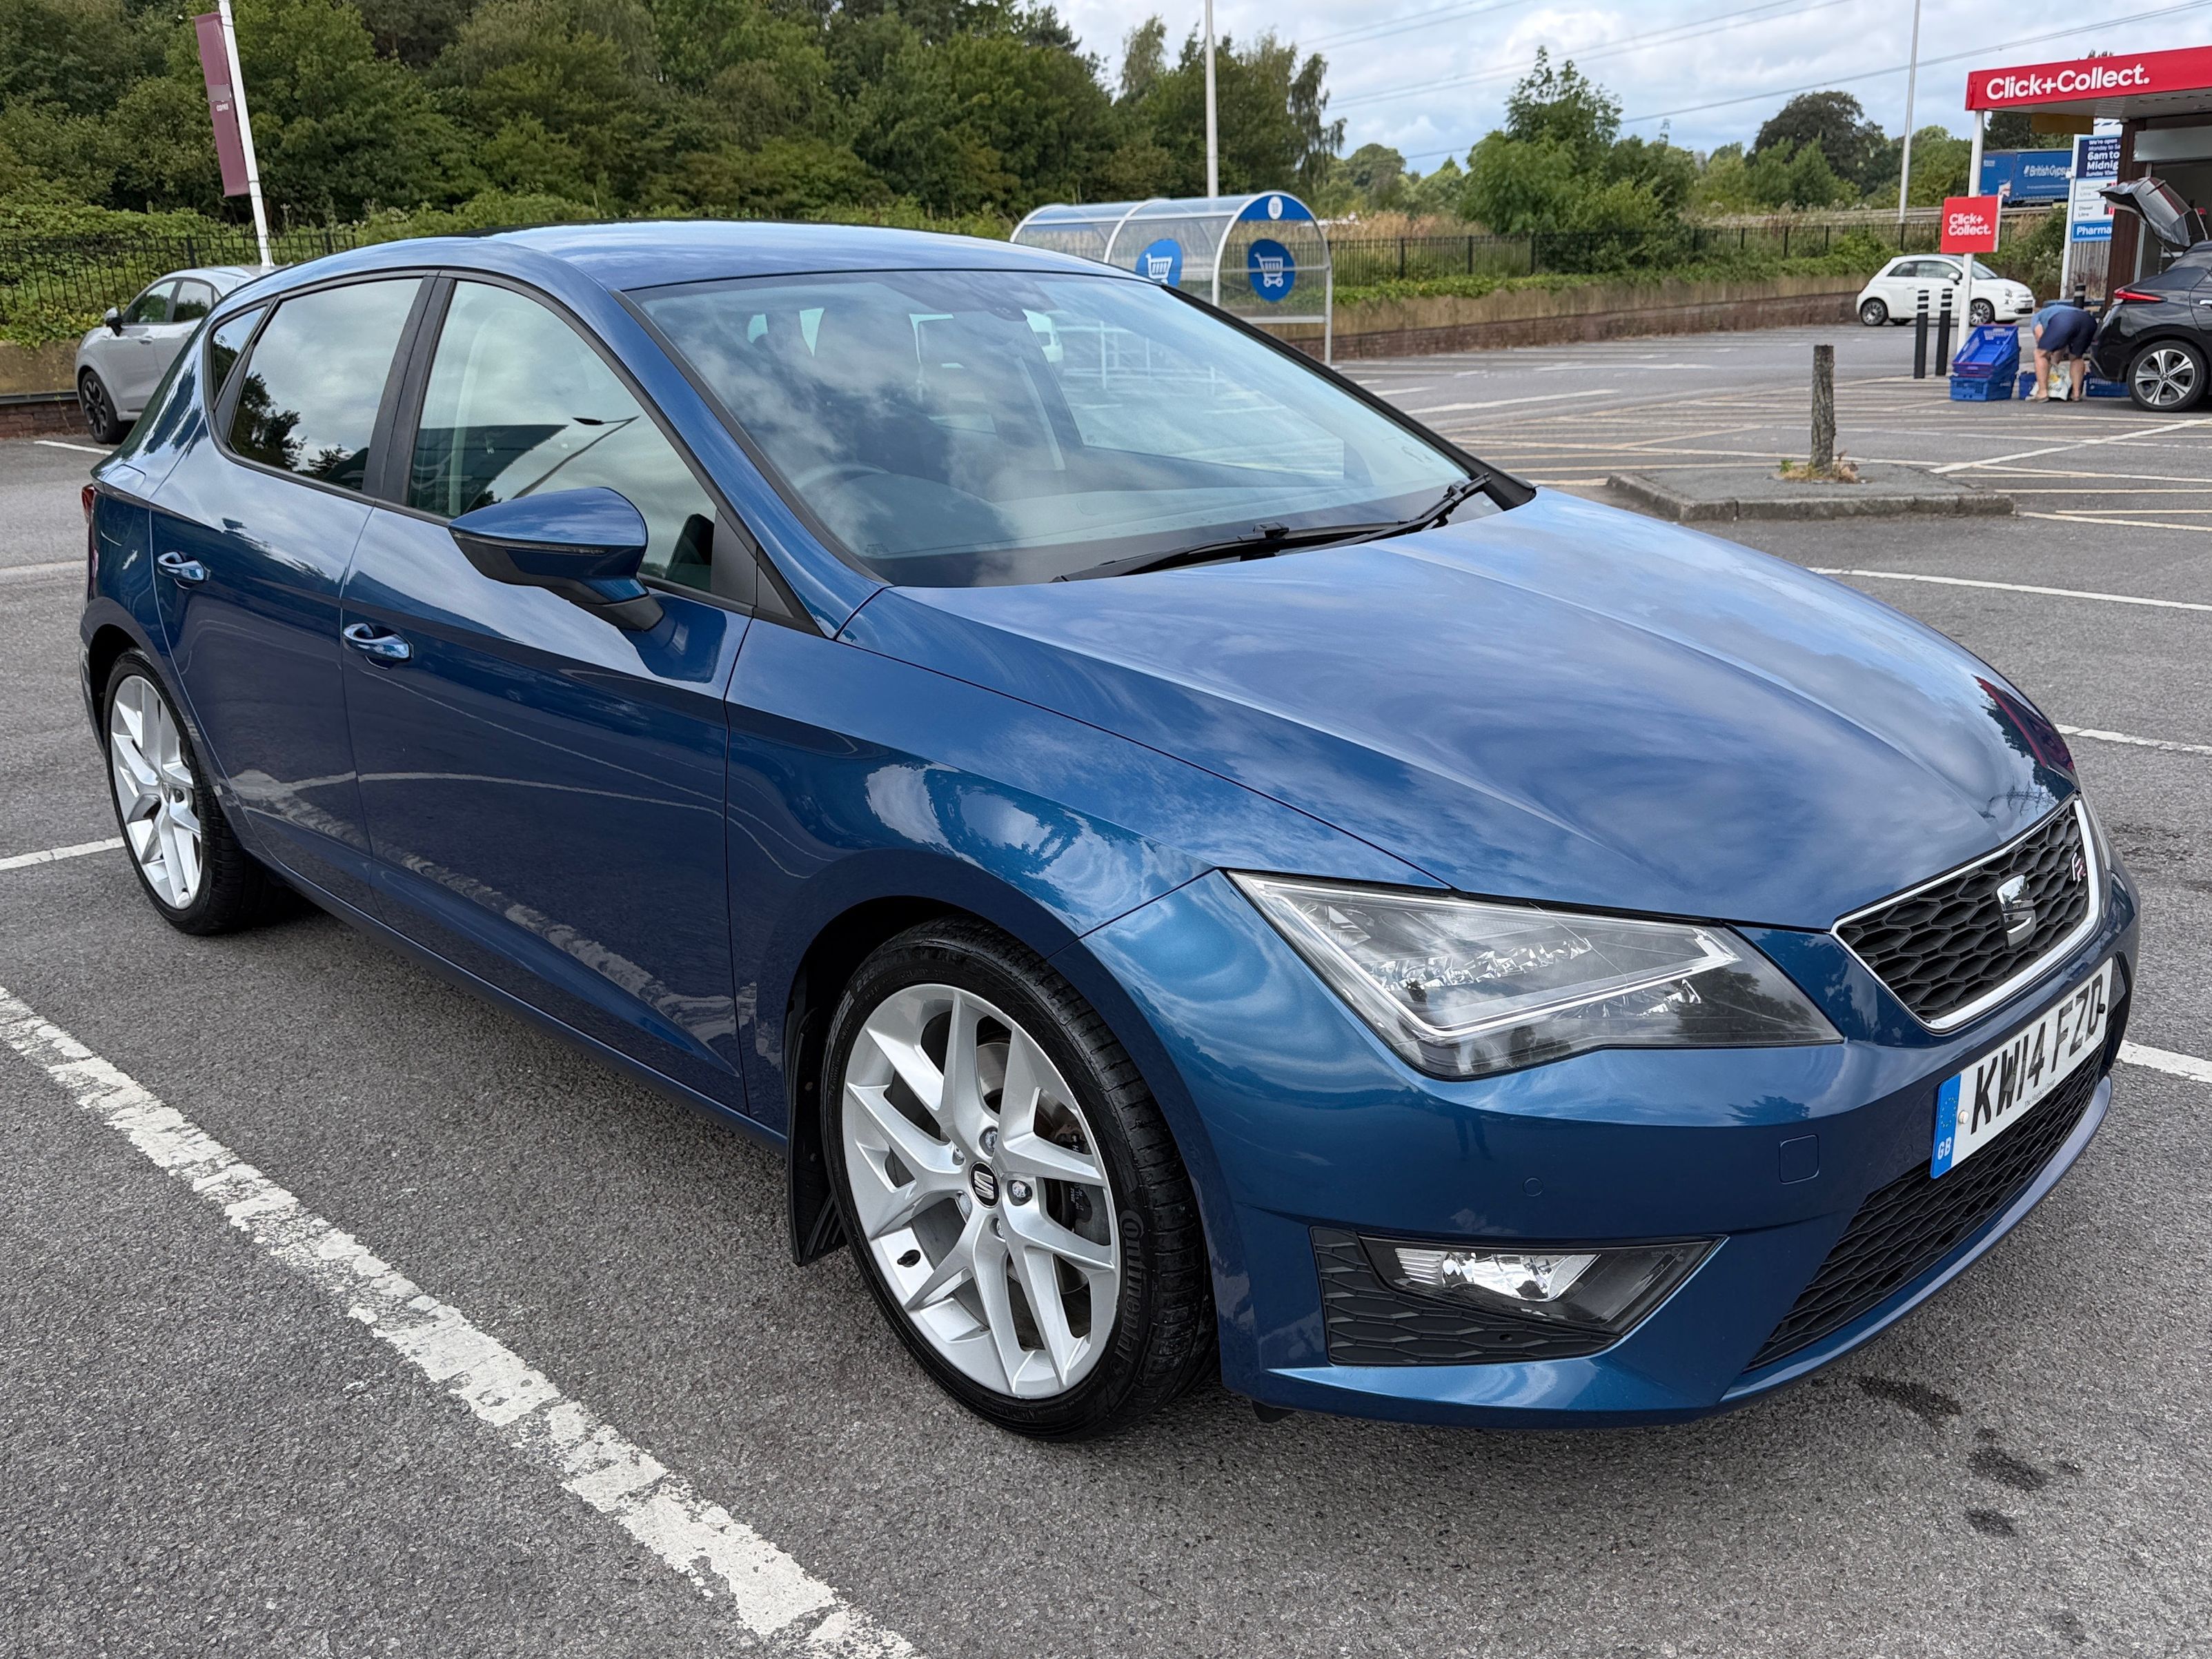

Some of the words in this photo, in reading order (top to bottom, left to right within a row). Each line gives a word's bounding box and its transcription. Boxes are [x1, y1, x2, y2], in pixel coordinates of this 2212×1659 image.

[1986, 63, 2150, 100] Click+Collect.
[2087, 151, 2108, 161] 6am
[2109, 150, 2120, 159] to
[2030, 165, 2049, 177] British
[1948, 212, 1984, 225] Click+
[1948, 223, 1992, 236] Collect.
[2076, 226, 2112, 235] Pharma
[1971, 1022, 2046, 1135] KW14
[1937, 1136, 1952, 1160] GB
[1114, 1210, 1145, 1364] Continental
